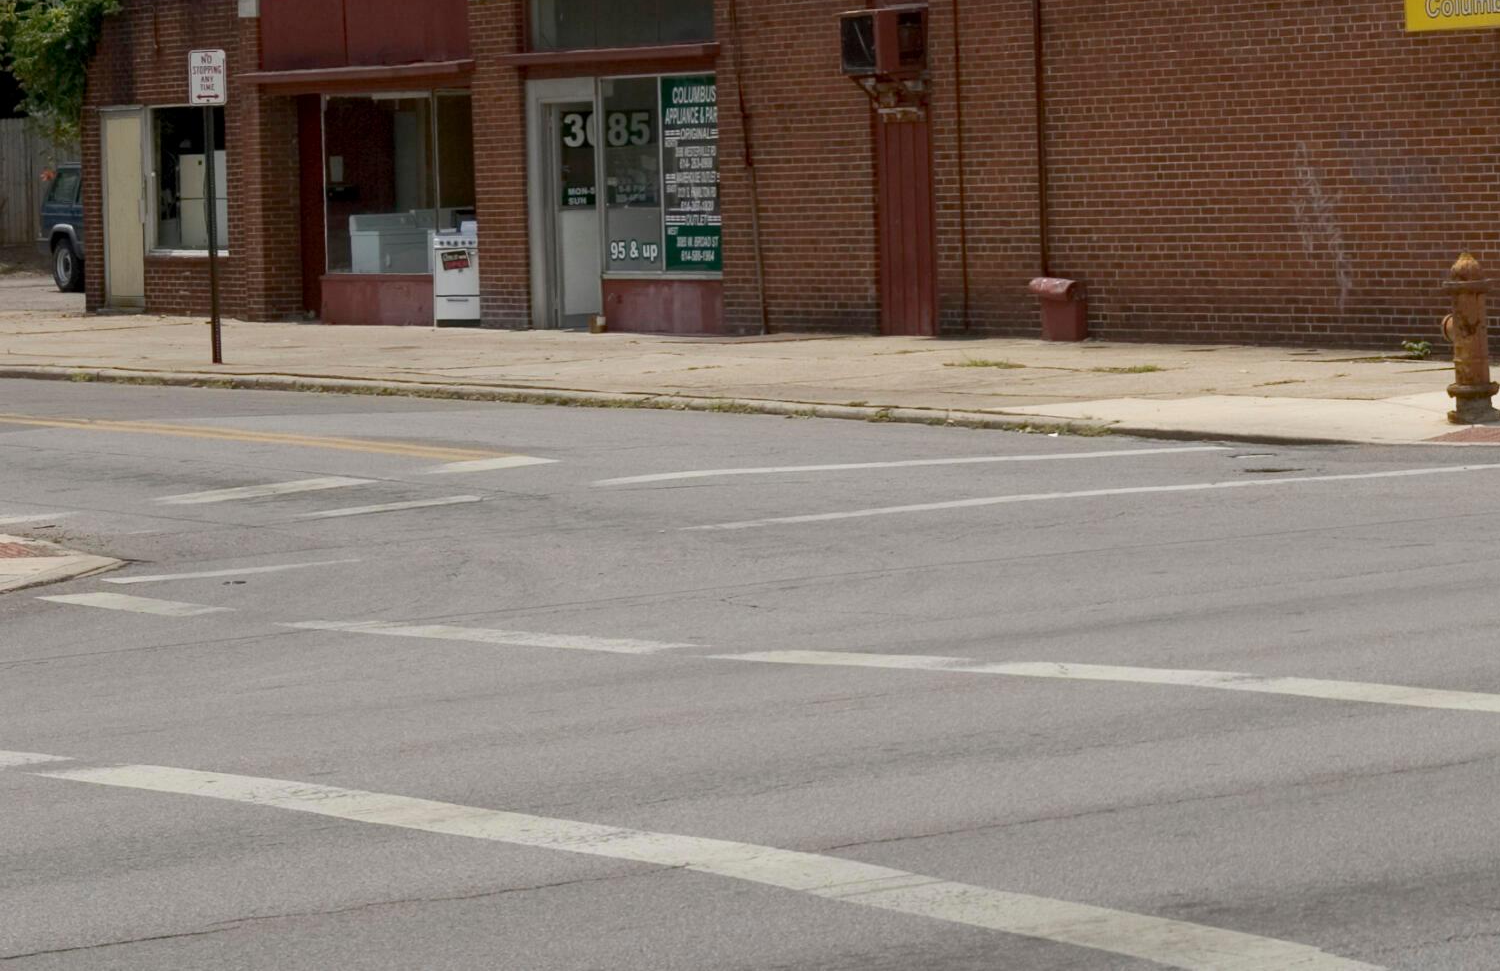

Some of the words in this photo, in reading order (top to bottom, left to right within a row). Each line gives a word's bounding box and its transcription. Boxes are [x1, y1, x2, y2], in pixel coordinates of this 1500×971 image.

[201, 55, 212, 64] NO
[192, 65, 222, 75] STOPPING
[200, 83, 215, 91] TIME
[672, 85, 716, 104] COLUMBUS
[665, 107, 699, 125] APPLIANCE
[705, 106, 718, 123] PAR
[567, 186, 595, 196] MON-S
[568, 197, 588, 206] SUN
[611, 241, 626, 259] 95
[630, 240, 639, 258] &
[642, 244, 658, 261] up
